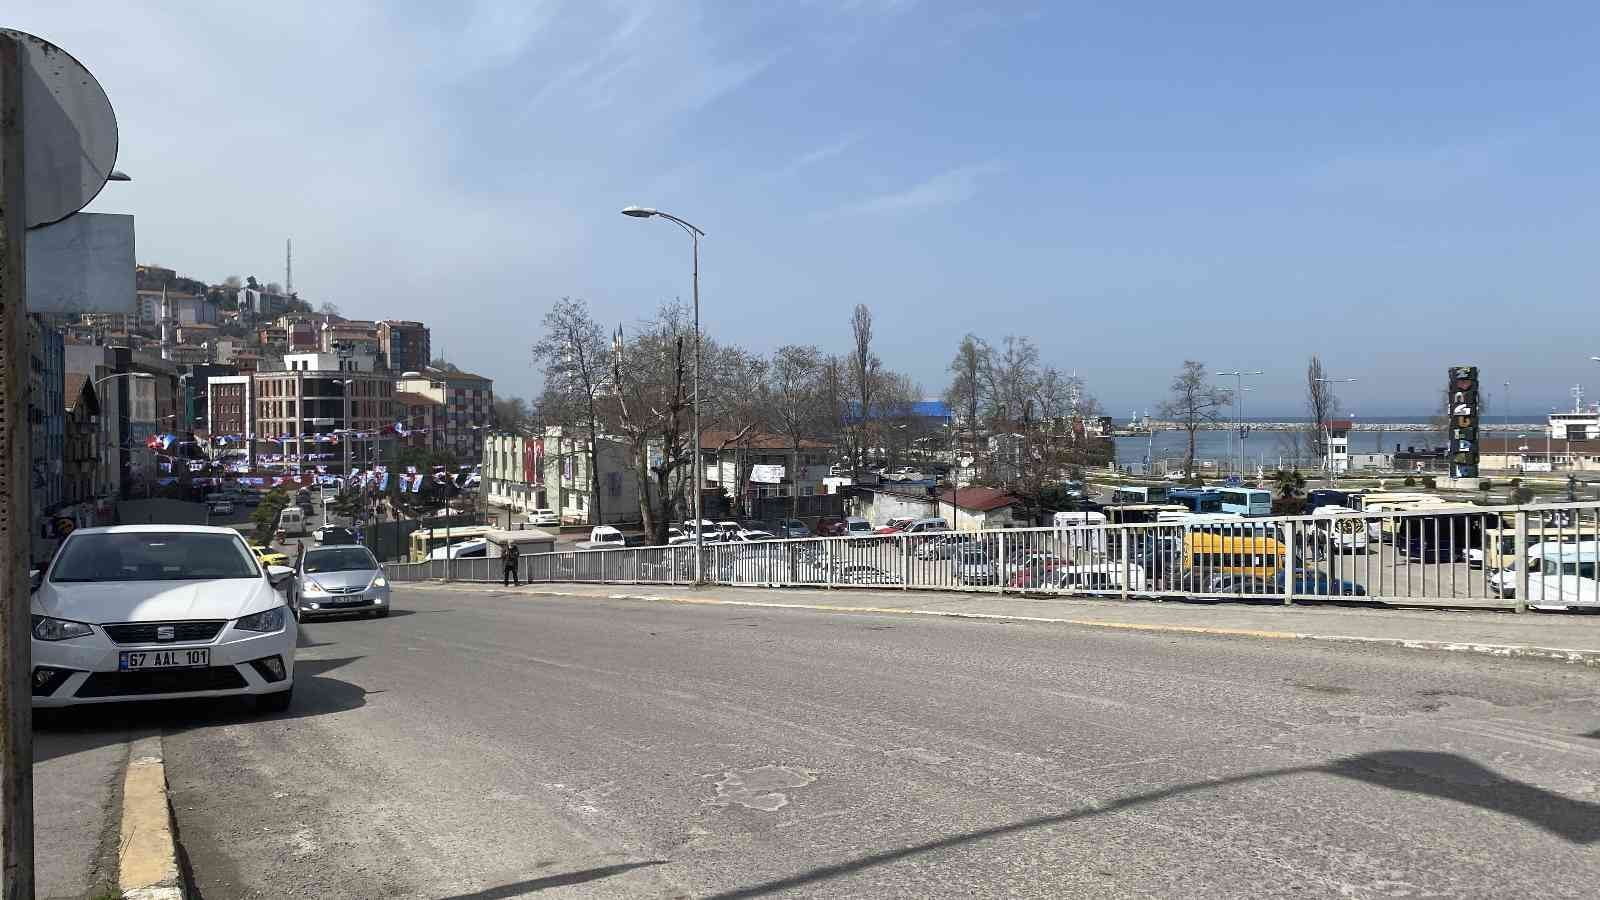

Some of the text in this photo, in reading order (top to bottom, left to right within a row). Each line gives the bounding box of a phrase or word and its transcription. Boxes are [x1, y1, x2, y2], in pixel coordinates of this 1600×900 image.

[129, 650, 207, 667] 67 AAL 101
